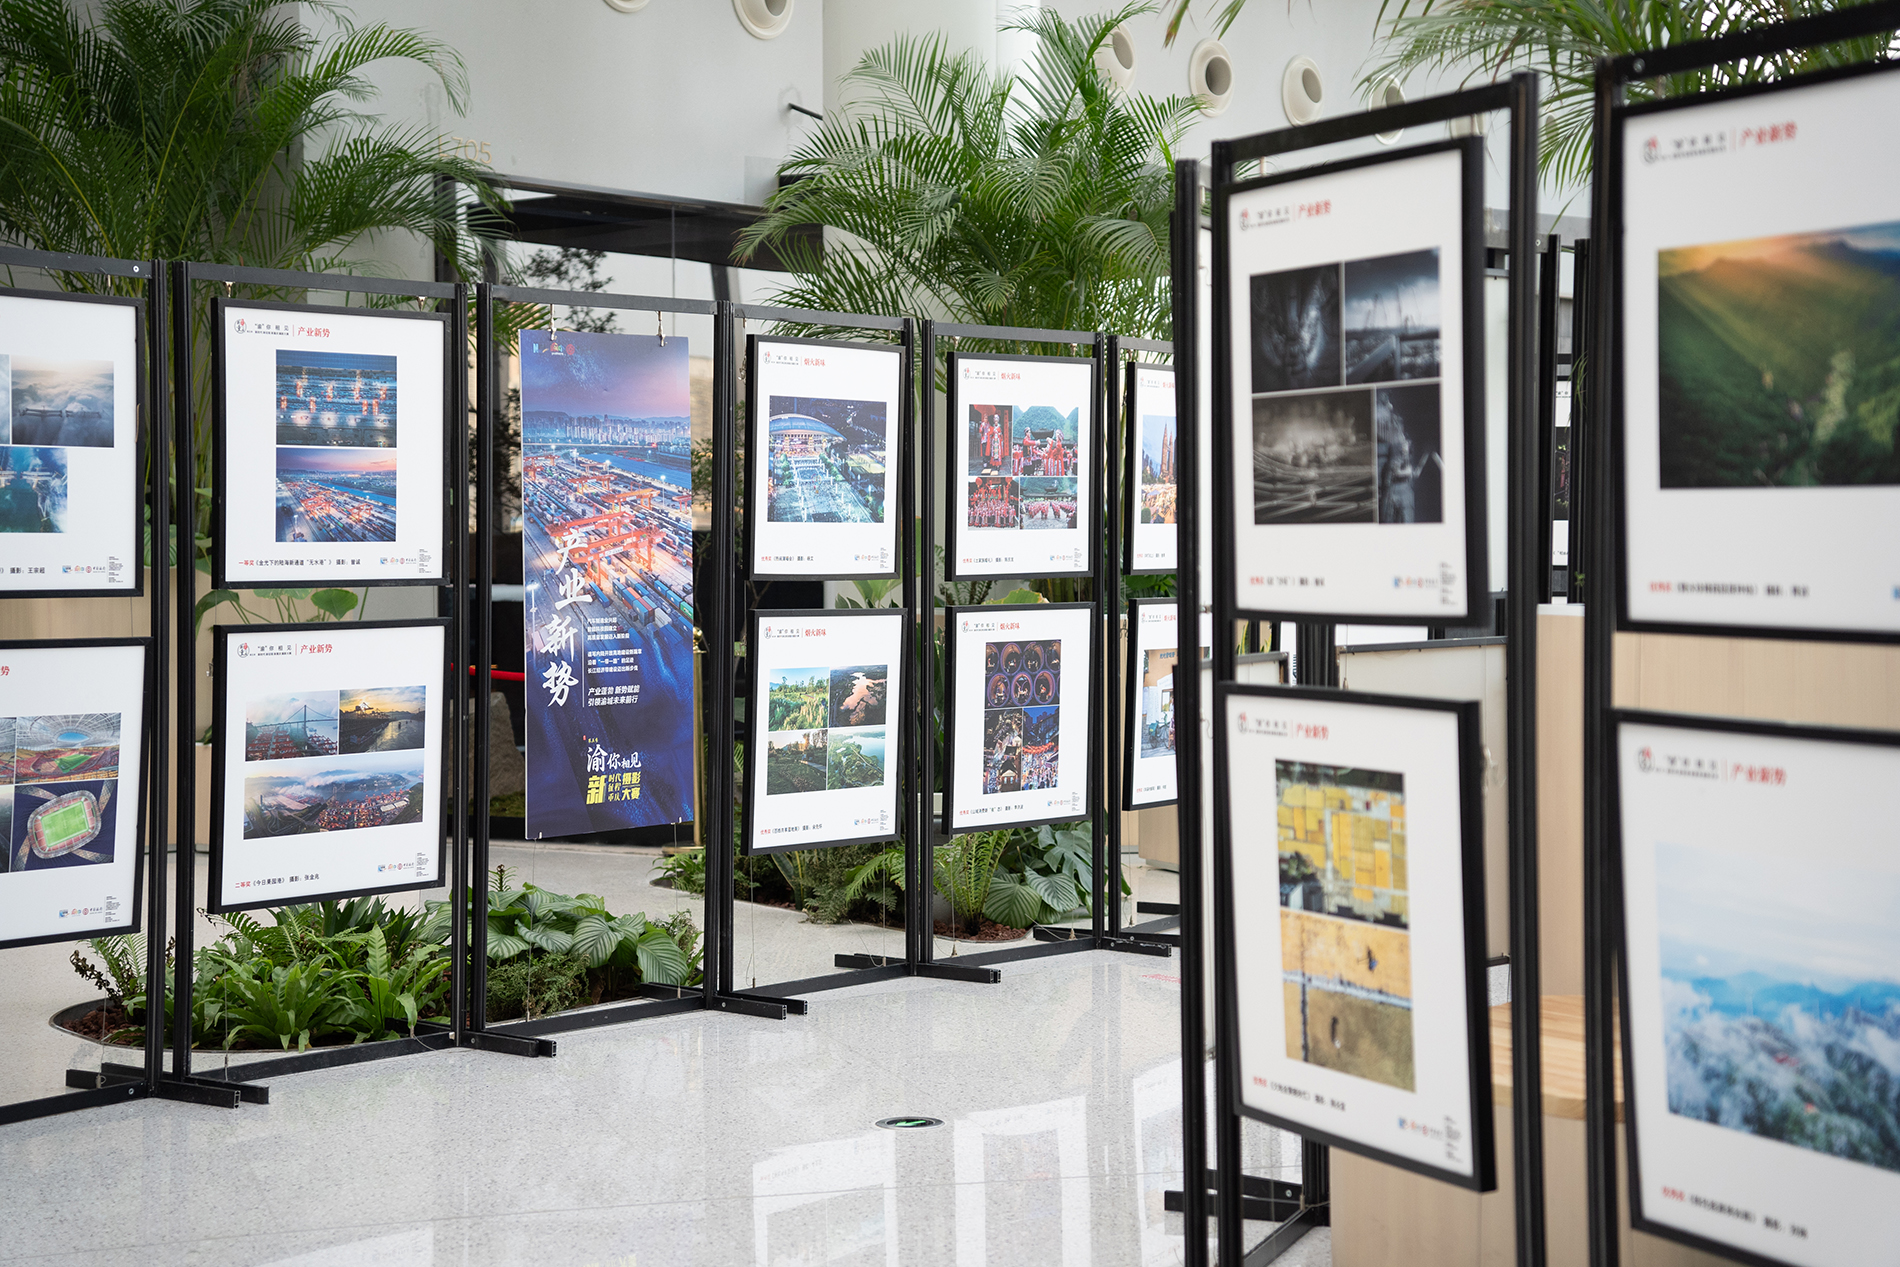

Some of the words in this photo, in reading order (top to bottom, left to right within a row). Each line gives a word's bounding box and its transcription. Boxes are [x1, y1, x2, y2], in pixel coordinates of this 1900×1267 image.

[297, 326, 331, 338] 产业新势
[300, 643, 333, 655] 产业新势
